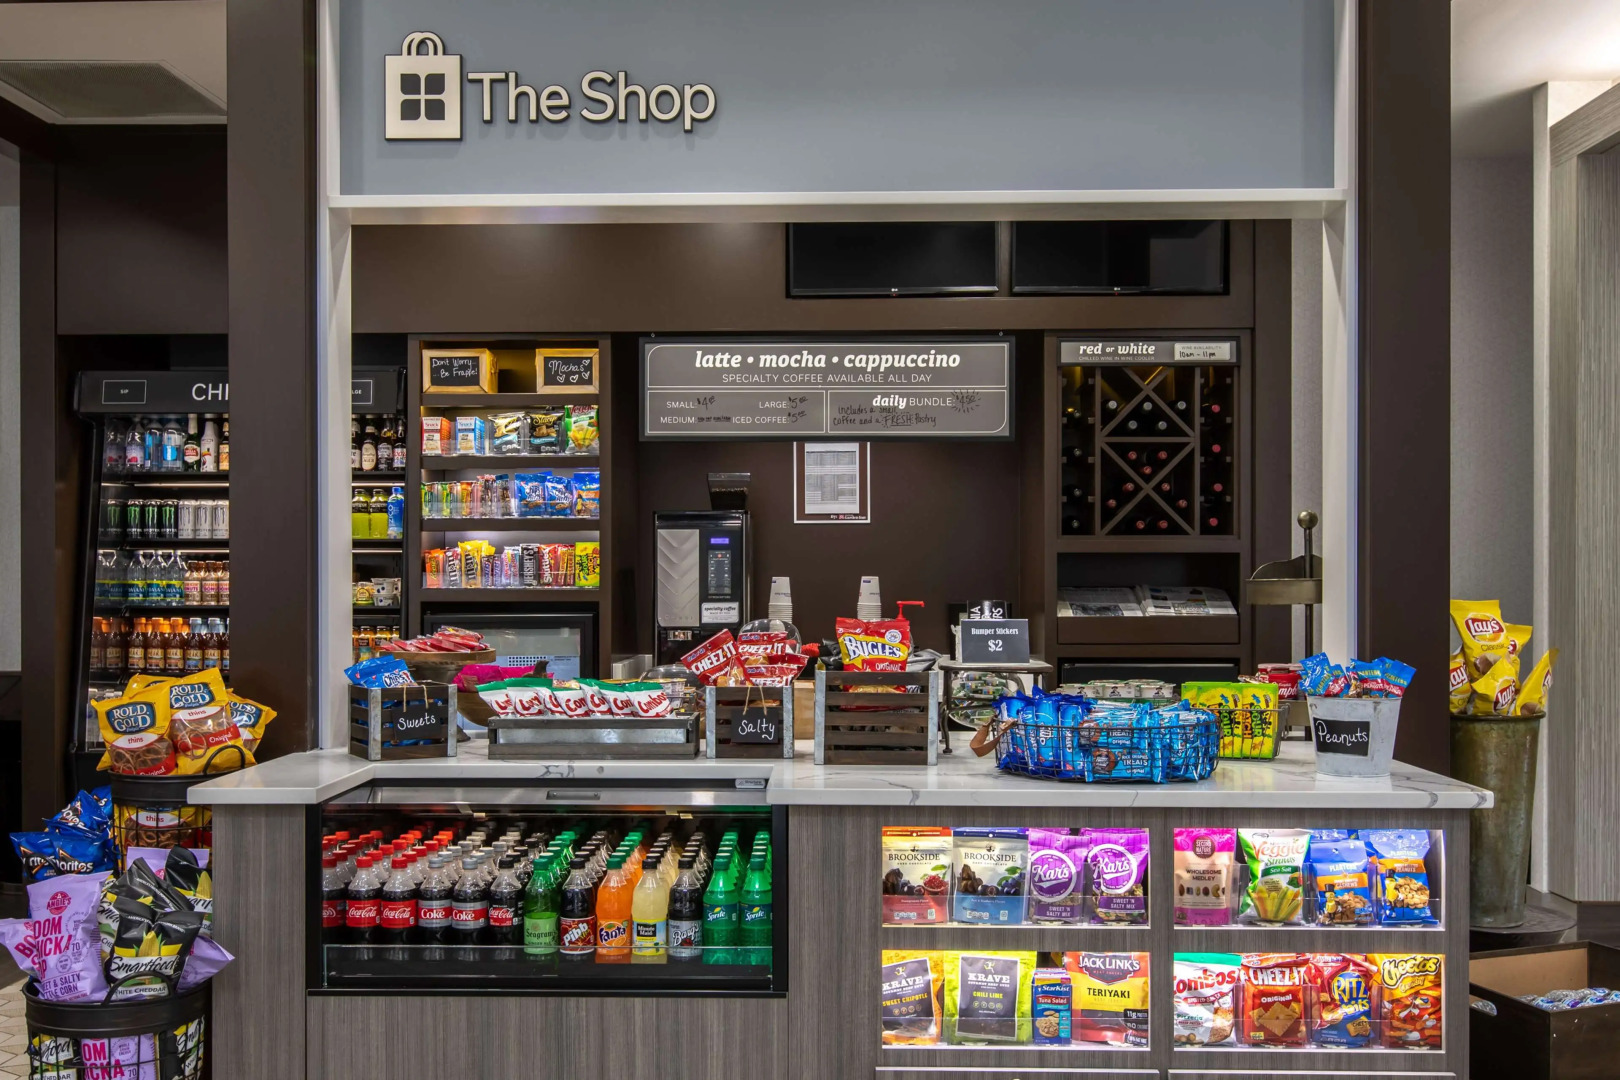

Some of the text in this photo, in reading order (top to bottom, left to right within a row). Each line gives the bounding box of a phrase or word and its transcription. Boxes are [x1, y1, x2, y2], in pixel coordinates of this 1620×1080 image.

[467, 70, 717, 132] The Shop
[1079, 343, 1102, 354] red
[1118, 343, 1156, 354] white
[696, 350, 961, 372] latte mocha cappuccino
[722, 374, 932, 383] SPECIALTY COFFEE AVAILABLE ALL DAY
[872, 394, 955, 409] daily BUNDLE:
[1469, 618, 1500, 636] Lay's
[845, 636, 903, 659] BUGLES
[988, 639, 1003, 652] $2
[171, 694, 210, 709] GOLD
[113, 704, 149, 719] ROLD
[114, 716, 155, 732] GOLD
[397, 713, 436, 730] Sweets
[738, 718, 776, 740] Salty
[128, 736, 144, 744] thins
[1316, 720, 1368, 747] Peanuts
[964, 853, 1016, 862] BROOKSIDE
[1252, 841, 1304, 860] Veggie
[1032, 864, 1069, 881] Kar's
[1098, 857, 1130, 873] Kar's
[46, 897, 71, 910] ANGIE'S
[421, 909, 445, 919] Coke
[452, 910, 475, 920] Coke
[708, 910, 726, 921] Sprite
[746, 910, 765, 921] Sprite
[34, 916, 62, 939] OOM
[563, 923, 588, 946] Pibb
[599, 926, 626, 943] Fanta
[72, 942, 80, 951] 70
[111, 956, 176, 974] Smartfood
[1079, 956, 1140, 970] JACK LINK'S
[968, 972, 1010, 983] KRAVE
[1383, 956, 1441, 987] Cheetos
[60, 973, 81, 986] SALTY
[882, 976, 924, 990] KRAVE
[1174, 969, 1236, 994] ombos
[60, 984, 78, 995] CORN
[1087, 988, 1130, 999] TERIYAKI
[1334, 977, 1369, 1001] RITZ
[882, 992, 928, 1006] SWEET CHIPOTLE
[128, 1068, 137, 1078] 70
